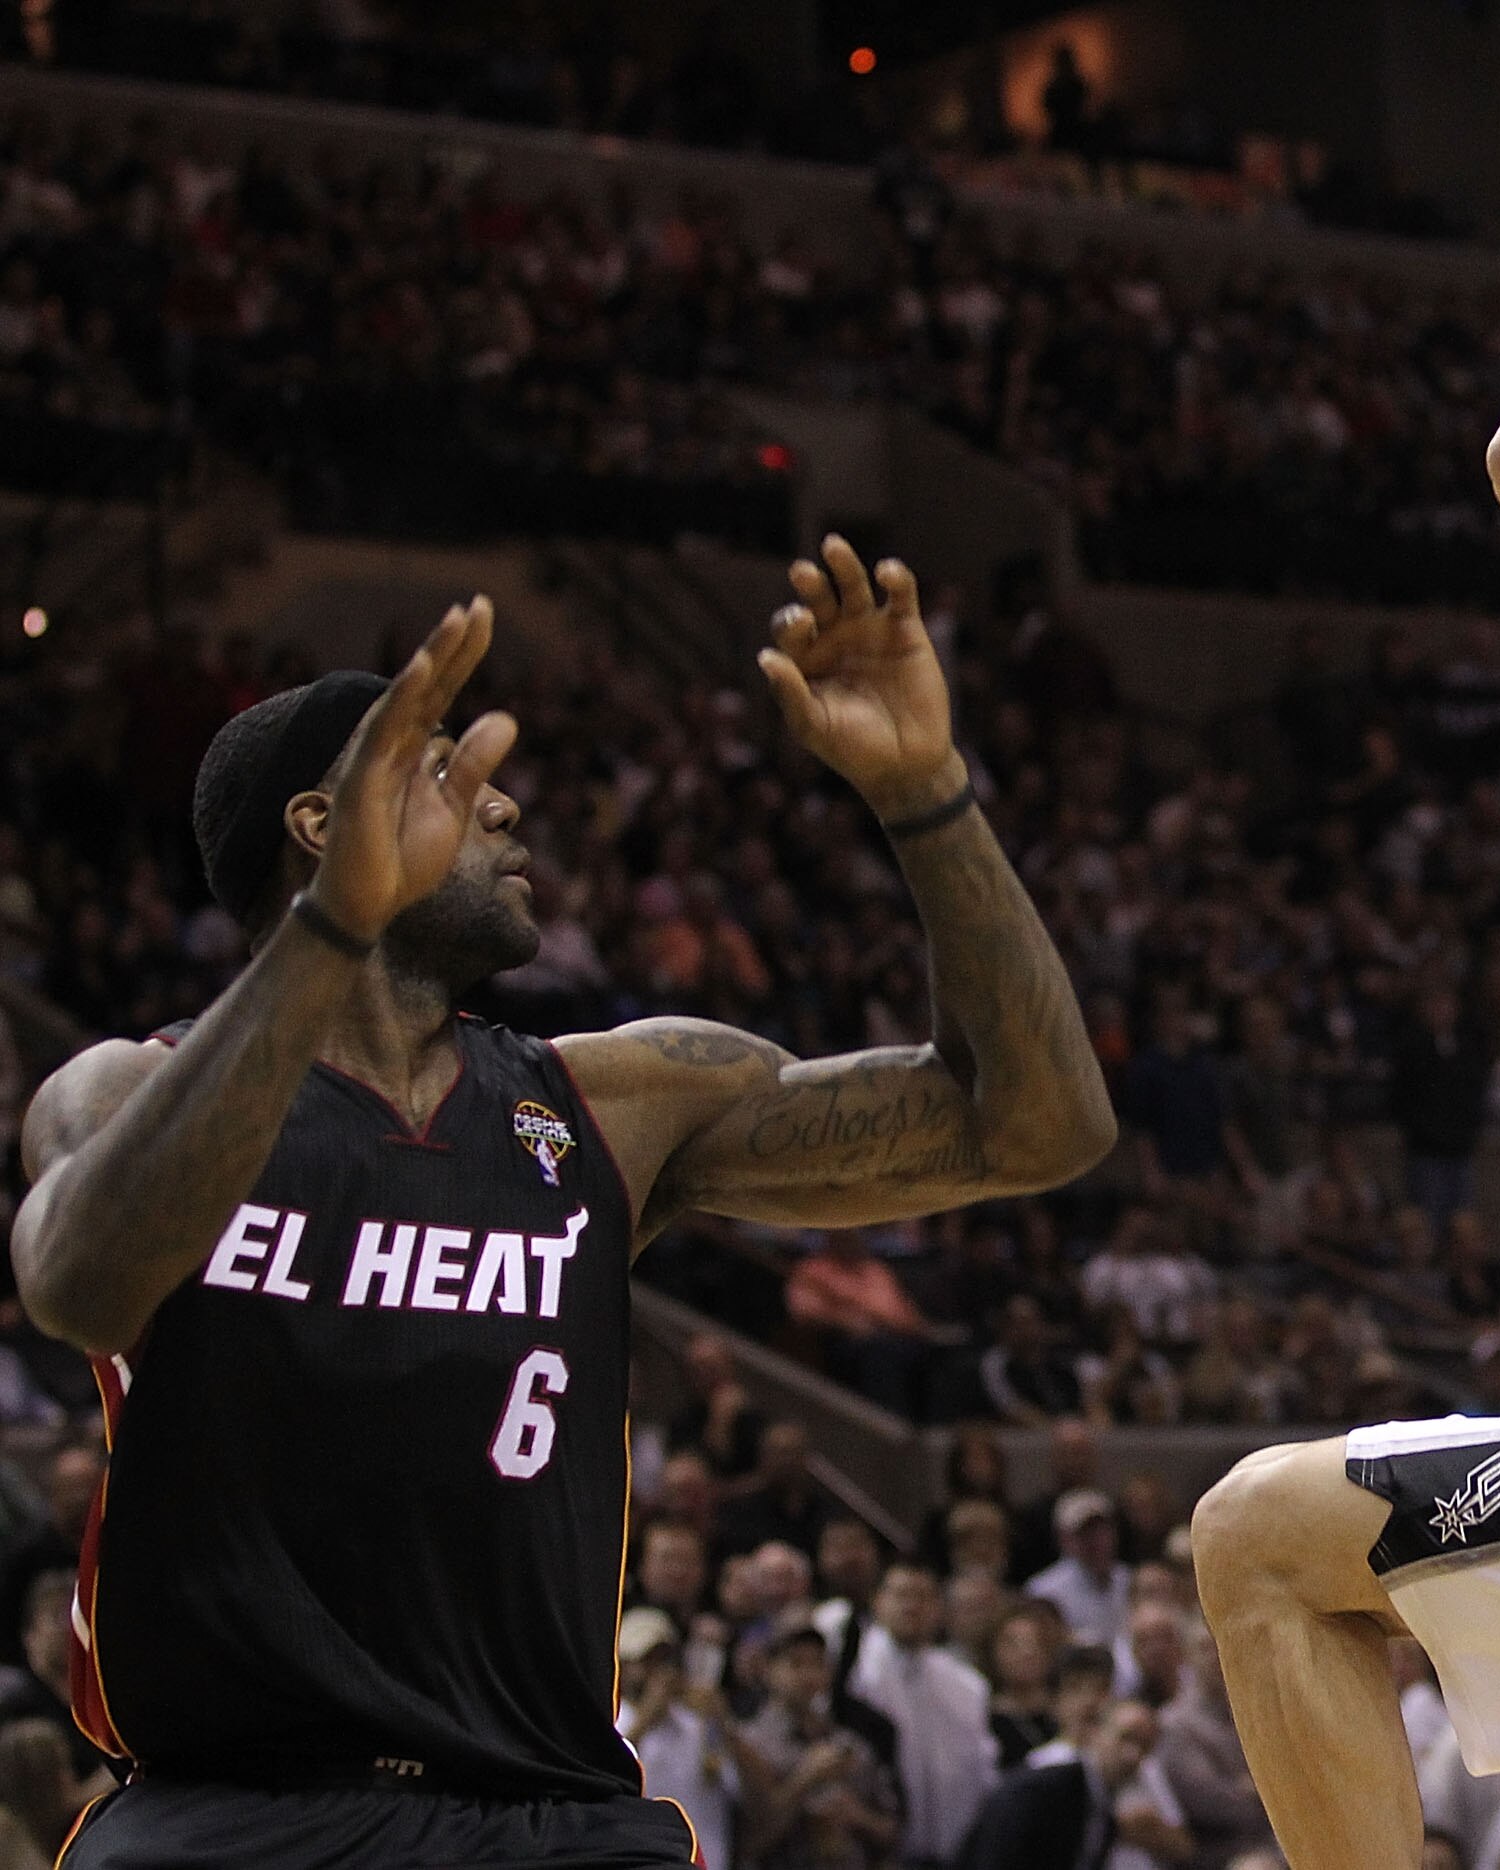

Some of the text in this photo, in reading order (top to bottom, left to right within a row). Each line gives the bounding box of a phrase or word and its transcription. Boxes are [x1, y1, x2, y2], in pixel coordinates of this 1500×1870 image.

[201, 1202, 591, 1319] EL HEAT
[487, 1345, 570, 1481] 6
